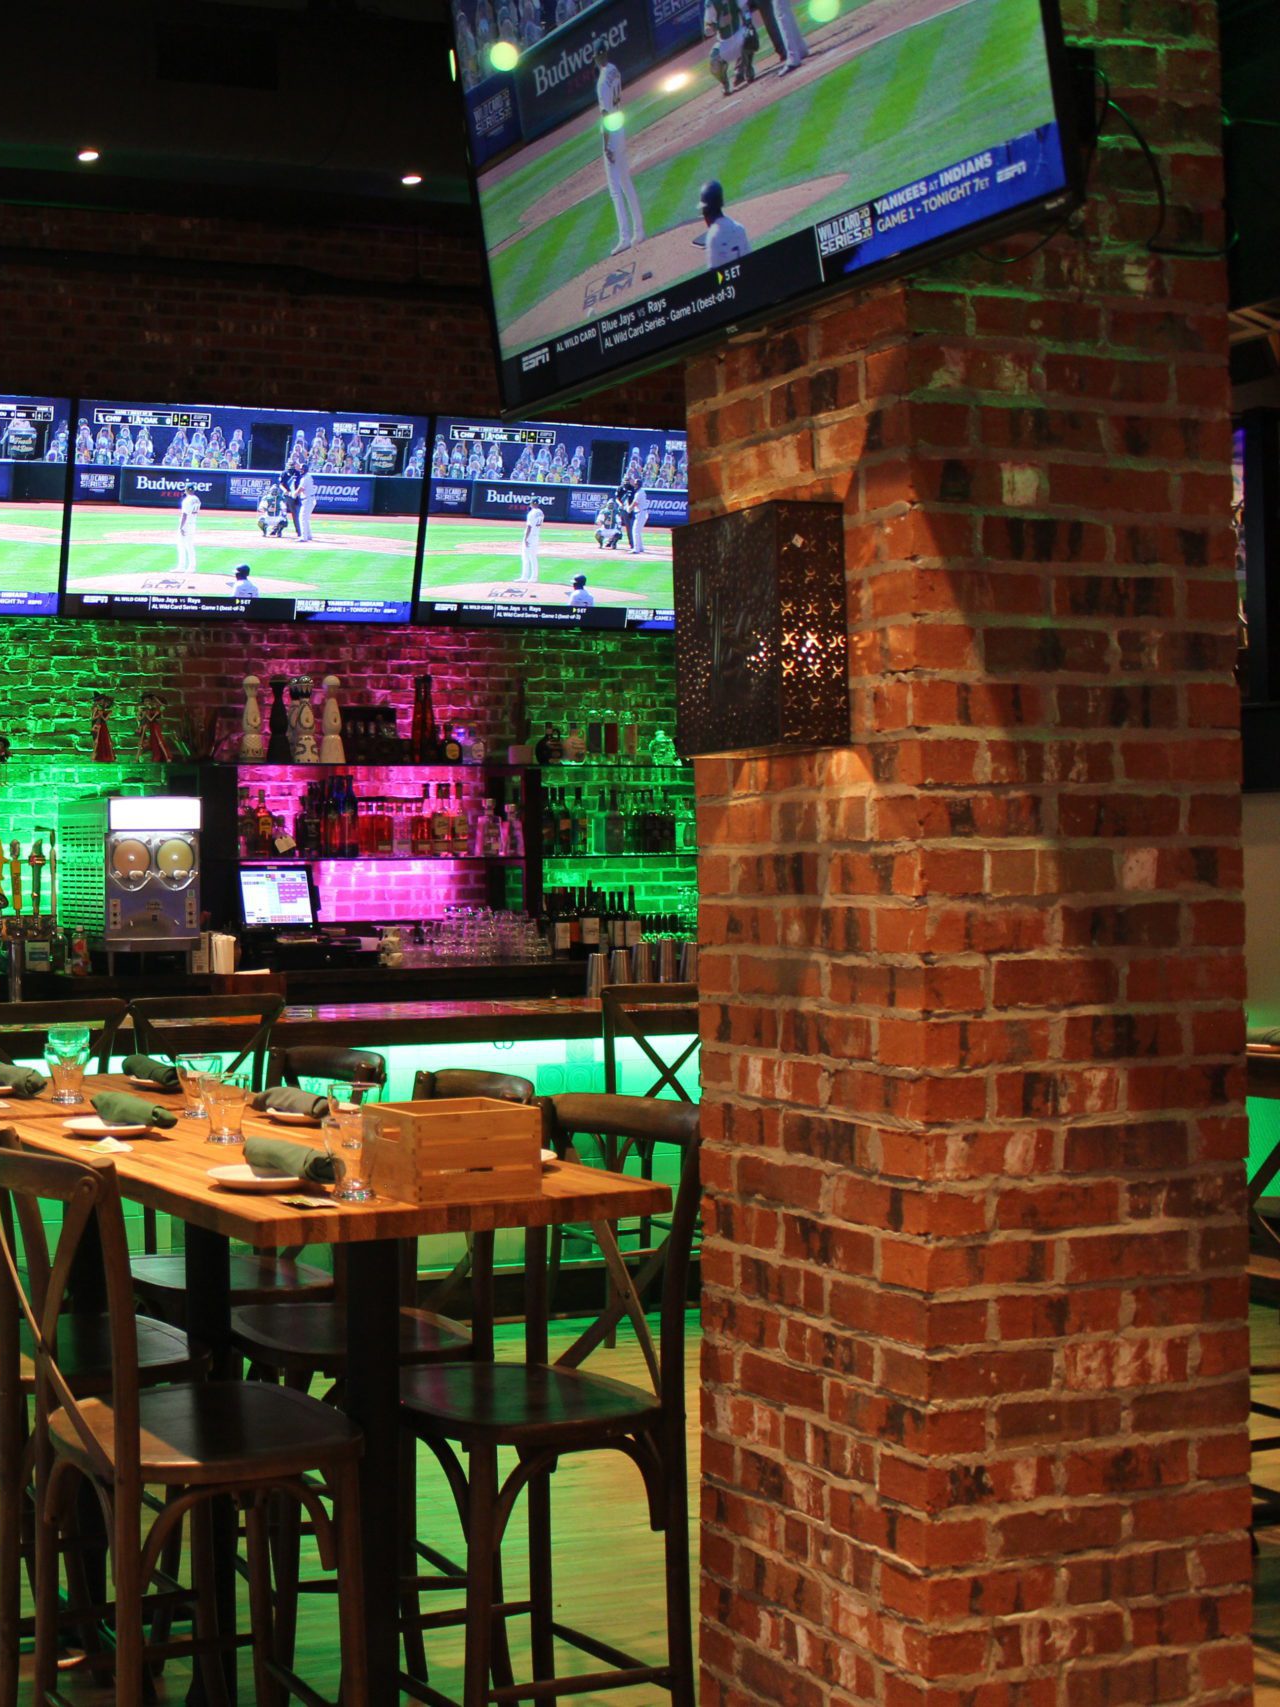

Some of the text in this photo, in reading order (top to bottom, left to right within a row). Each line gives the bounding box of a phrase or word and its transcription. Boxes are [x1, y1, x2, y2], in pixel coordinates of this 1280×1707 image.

[874, 181, 927, 215] YANKEES
[939, 152, 992, 187] INDIANS
[877, 208, 907, 232] GAME
[922, 181, 971, 213] TONIGHT
[818, 211, 859, 241] WILD CARD
[820, 227, 862, 255] SERIES
[731, 265, 740, 277] ET
[601, 317, 617, 332] Blue
[618, 309, 635, 327] Jays
[648, 295, 666, 315] Rays
[604, 336, 612, 348] AL
[613, 329, 626, 344] Wild
[628, 323, 643, 338] Card
[644, 314, 665, 331] Series
[670, 303, 690, 321] Game
[556, 328, 595, 351] AL WILD CARD
[522, 347, 549, 371] ESPN
